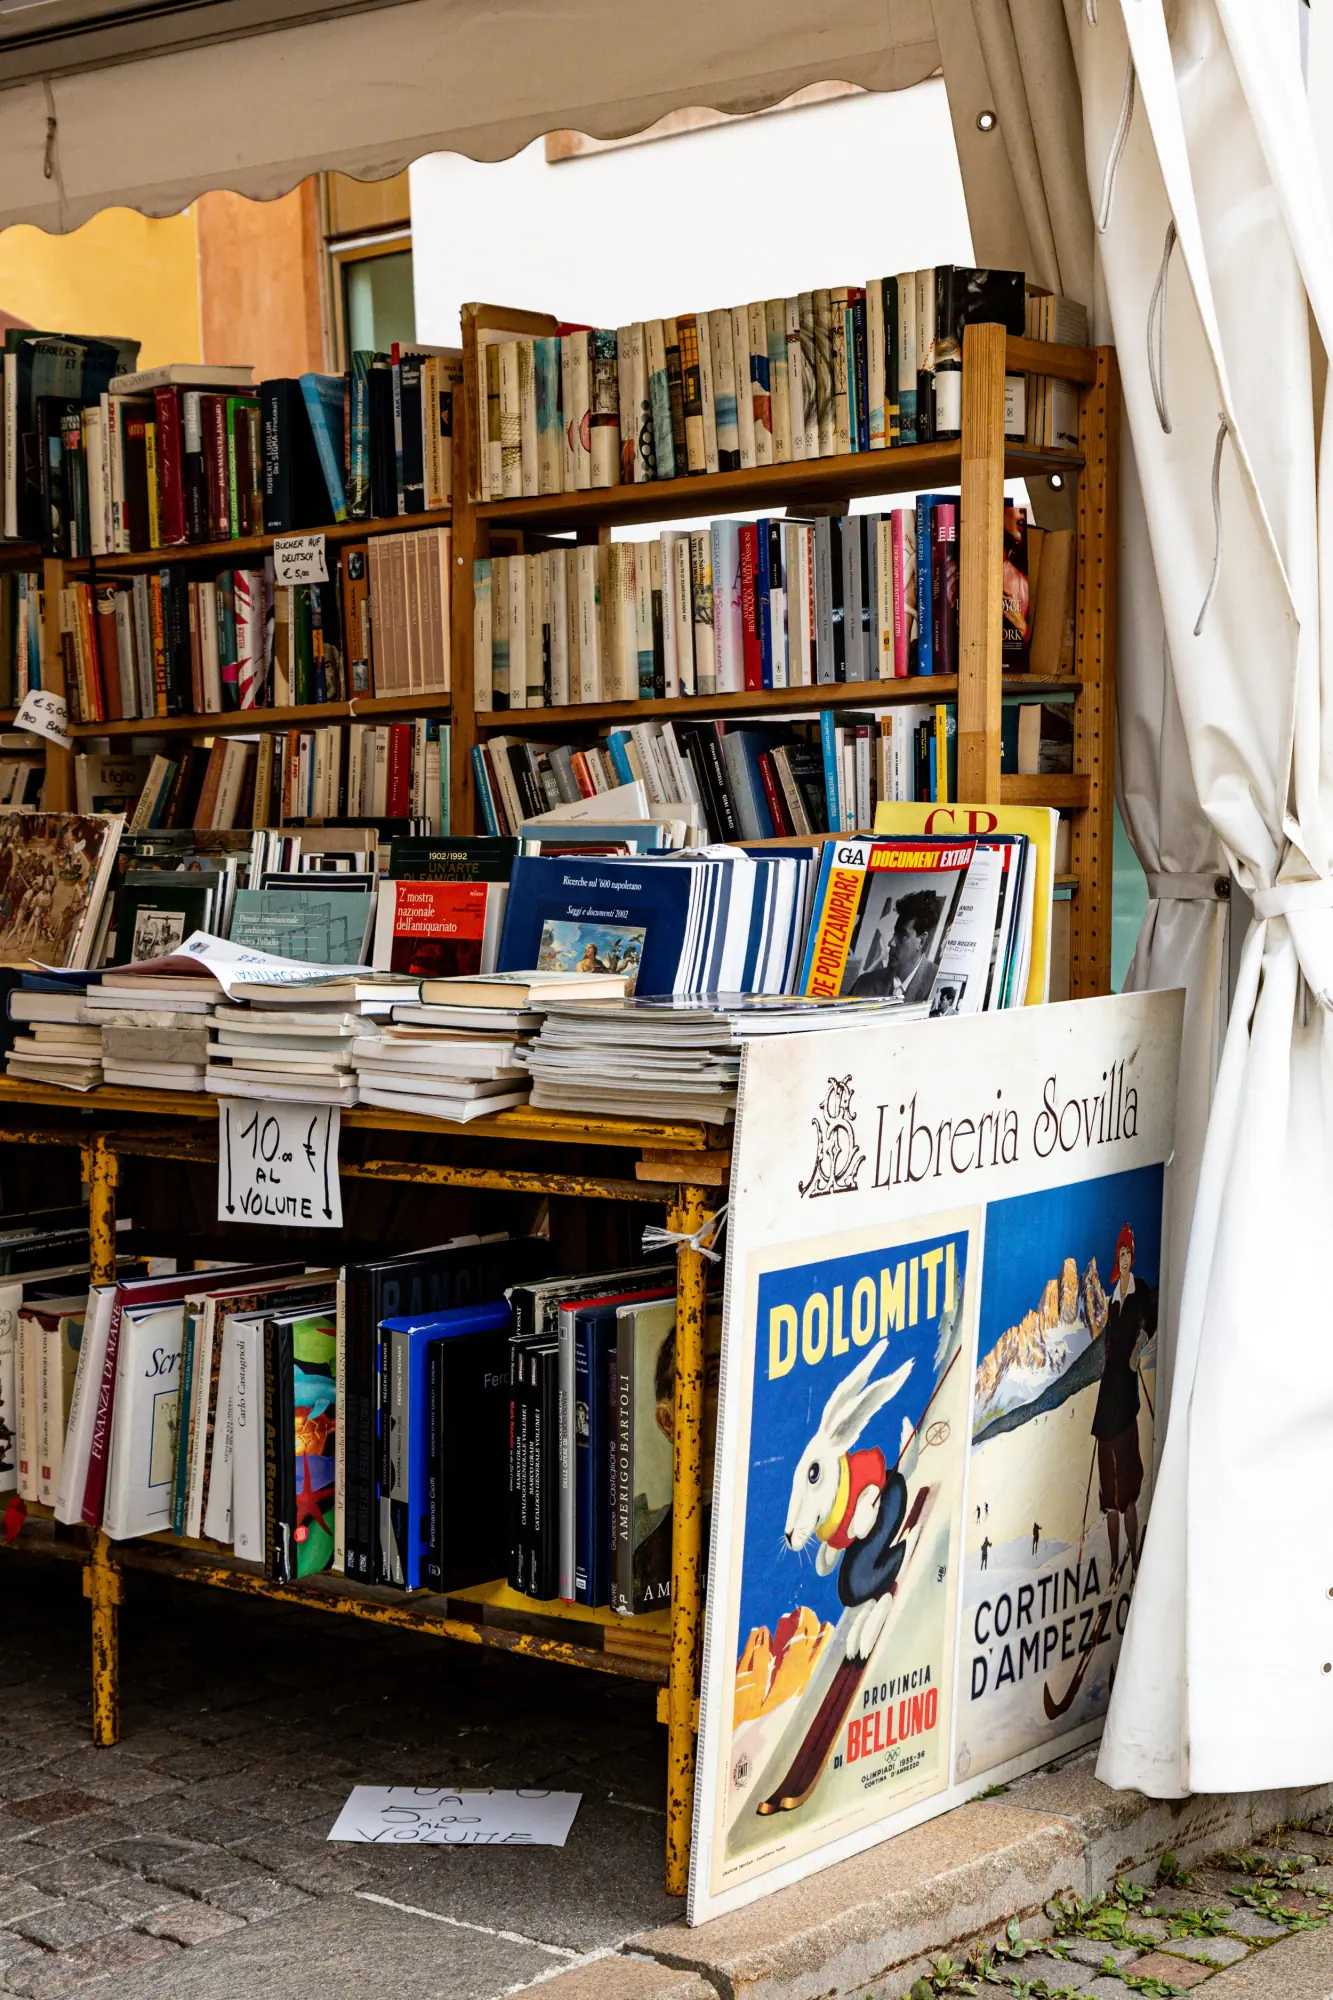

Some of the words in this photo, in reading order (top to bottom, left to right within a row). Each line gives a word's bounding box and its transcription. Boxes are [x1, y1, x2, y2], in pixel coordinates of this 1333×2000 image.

[265, 421, 273, 456] LUDLUM
[266, 460, 274, 495] ROBERT
[272, 462, 280, 475] Das
[275, 539, 304, 550] BÜCHER
[307, 536, 322, 547] AUF
[281, 552, 314, 563] DEUTSCH
[20, 711, 37, 725] PRO
[428, 851, 468, 861] 1902/1992
[428, 861, 480, 874] UN'ARTE
[837, 847, 866, 866] GA
[870, 849, 941, 868] DOCUMENT
[940, 847, 974, 866] EXTRA
[407, 891, 434, 904] mostra
[562, 875, 588, 888] Ricerche
[588, 877, 598, 888] sul
[598, 878, 611, 889] '600
[611, 881, 642, 892] napoletano
[238, 914, 260, 923] Premio
[261, 915, 299, 924] internazionale
[397, 905, 435, 918] nazionale
[566, 905, 582, 919] Saggi
[586, 909, 615, 919] documenti
[615, 909, 629, 919] 2002
[821, 871, 859, 976] PORTZAMPARC
[255, 937, 279, 946] Palladio
[395, 918, 458, 937] dell'antiquariato
[957, 940, 977, 948] ROGERS
[870, 1088, 1019, 1190] Libreria
[1032, 1058, 1139, 1159] Sovilla
[255, 1167, 281, 1184] AL
[239, 1186, 313, 1219] VOLUME
[767, 1241, 956, 1382] DOLOMITI
[107, 1306, 122, 1356] MARE
[103, 1361, 114, 1379] DI
[236, 1340, 248, 1396] Castagnoli
[264, 1322, 278, 1416] Cracking
[68, 1383, 82, 1433] FREDERIC
[91, 1383, 111, 1460] FINANZA
[237, 1398, 247, 1428] Carlo
[619, 1374, 630, 1452] BARTOLI
[264, 1422, 277, 1456] Art
[608, 1440, 618, 1506] Castiglione
[428, 1476, 436, 1500] Cioffi
[618, 1456, 630, 1541] AMERIGO
[264, 1460, 276, 1577] Revolution
[974, 1555, 1101, 1646] CORTINA
[970, 1592, 1131, 1702] D'AMPEZZO
[862, 1663, 932, 1710] PROVINCIA
[833, 1753, 844, 1770] DI
[845, 1686, 939, 1765] BELLUNO
[861, 1763, 895, 1783] OLIMPIADI
[899, 1750, 926, 1767] 1955-56
[864, 1775, 887, 1789] CORTINA
[890, 1761, 920, 1778] D'AMPEZZO
[438, 1795, 464, 1807] A
[356, 1827, 537, 1844] VOLUME
[417, 1821, 449, 1830] AL
